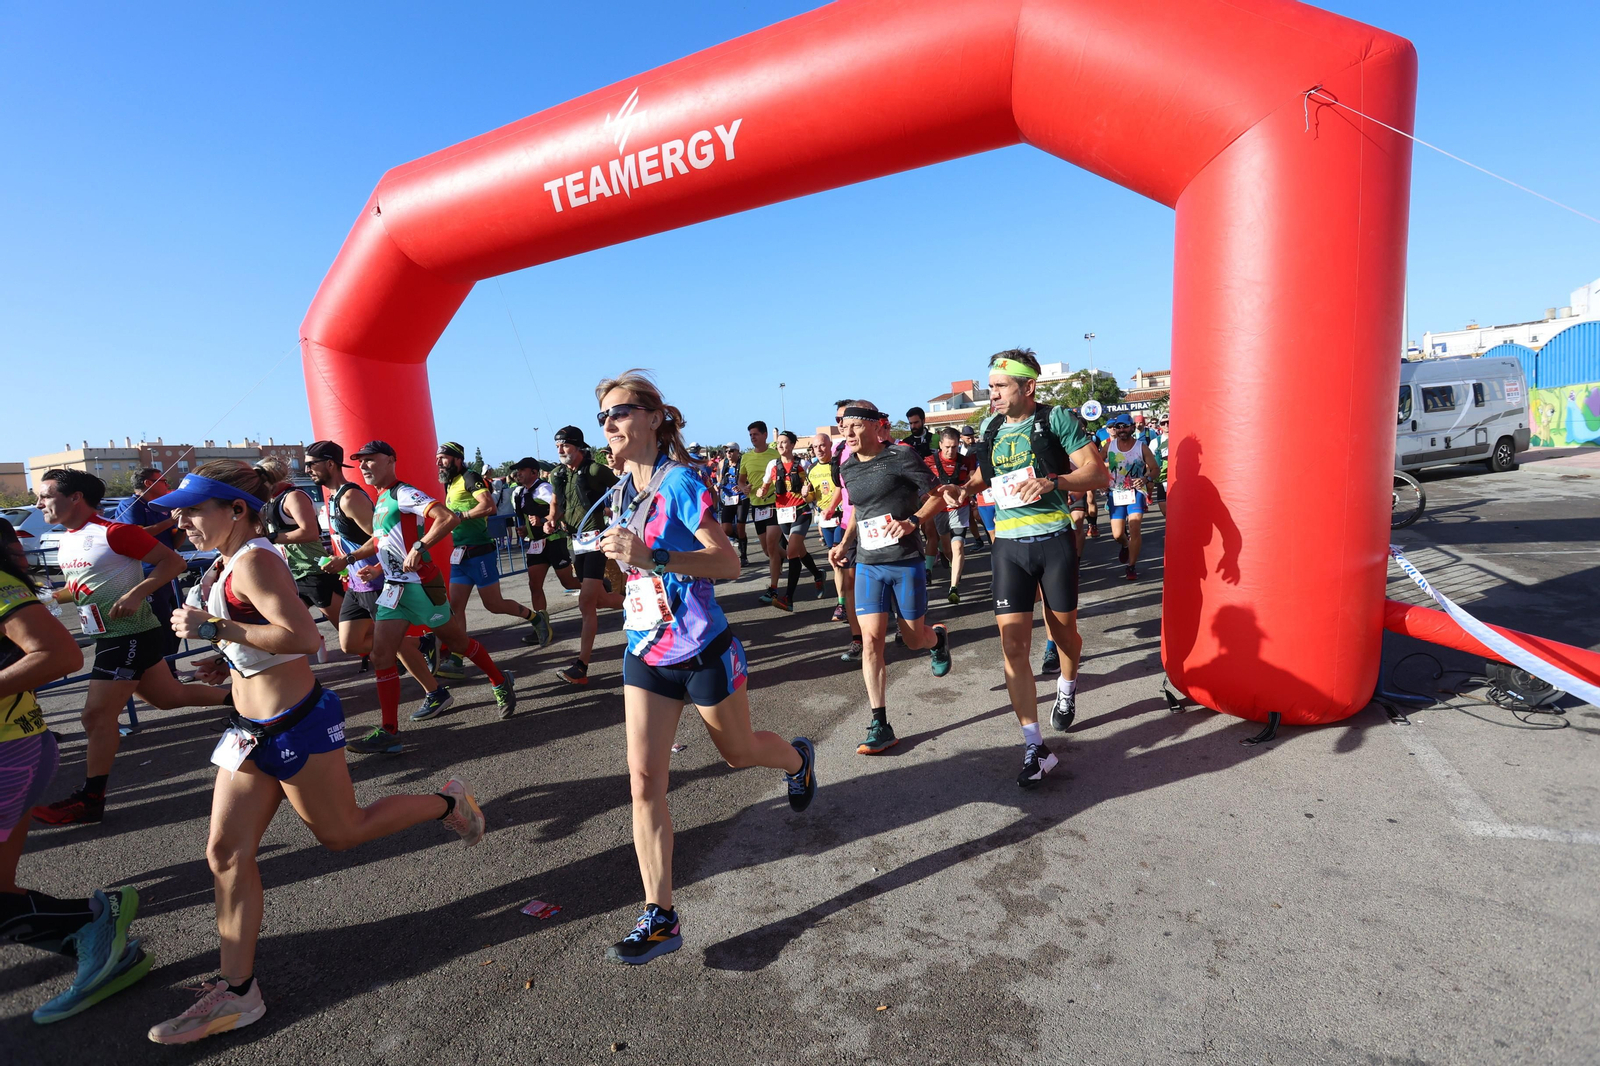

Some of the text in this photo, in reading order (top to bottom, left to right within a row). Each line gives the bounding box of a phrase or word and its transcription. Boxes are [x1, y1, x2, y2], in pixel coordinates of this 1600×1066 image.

[543, 118, 743, 213] TEAMERGY
[1107, 404, 1129, 412] TRAIL
[867, 529, 880, 539] 43
[630, 597, 643, 613] 85
[125, 640, 137, 665] WONG
[109, 894, 120, 917] HOKA
